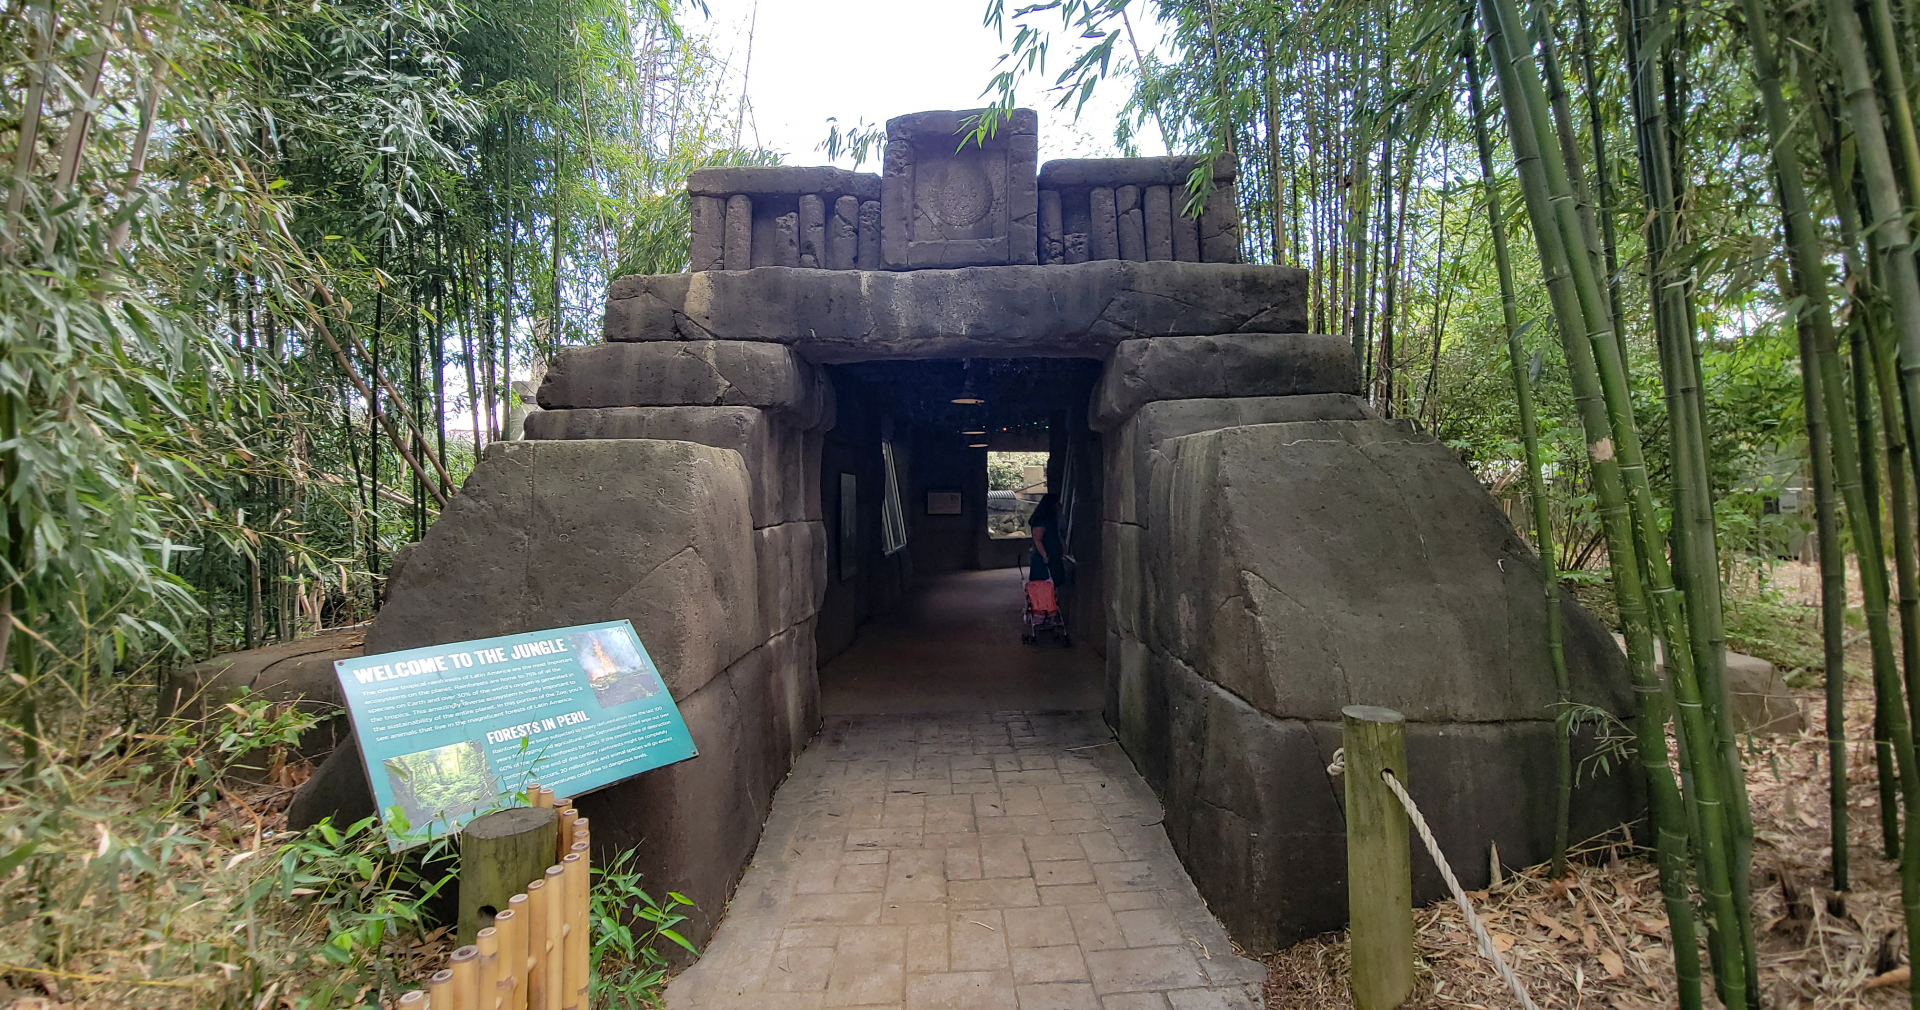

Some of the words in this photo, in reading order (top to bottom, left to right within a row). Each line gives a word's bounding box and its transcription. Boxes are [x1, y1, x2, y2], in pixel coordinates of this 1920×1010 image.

[353, 656, 447, 683] WELCOME
[449, 652, 473, 668] TO
[473, 647, 508, 664] THE
[511, 638, 567, 659] JUNGLE
[399, 681, 426, 689] tropical
[427, 676, 461, 685] rainforests
[546, 657, 573, 665] important
[364, 694, 406, 704] ecosystems
[430, 686, 452, 694] planet.
[453, 680, 488, 689] Rainforests
[367, 705, 395, 713] species
[540, 673, 568, 683] generated
[383, 712, 410, 720] tropics.
[427, 702, 461, 712] amazingly
[485, 692, 518, 701] ecosystem
[542, 681, 569, 690] important
[386, 717, 432, 729] sustainability
[474, 704, 496, 713] planet.
[516, 696, 537, 704] portion
[390, 729, 418, 738] animals
[467, 711, 504, 723] magnificent
[549, 697, 572, 705] America.
[486, 721, 541, 744] FORESTS
[541, 717, 556, 731] IN
[556, 710, 590, 727] PERIL
[491, 743, 521, 754] Rainforest
